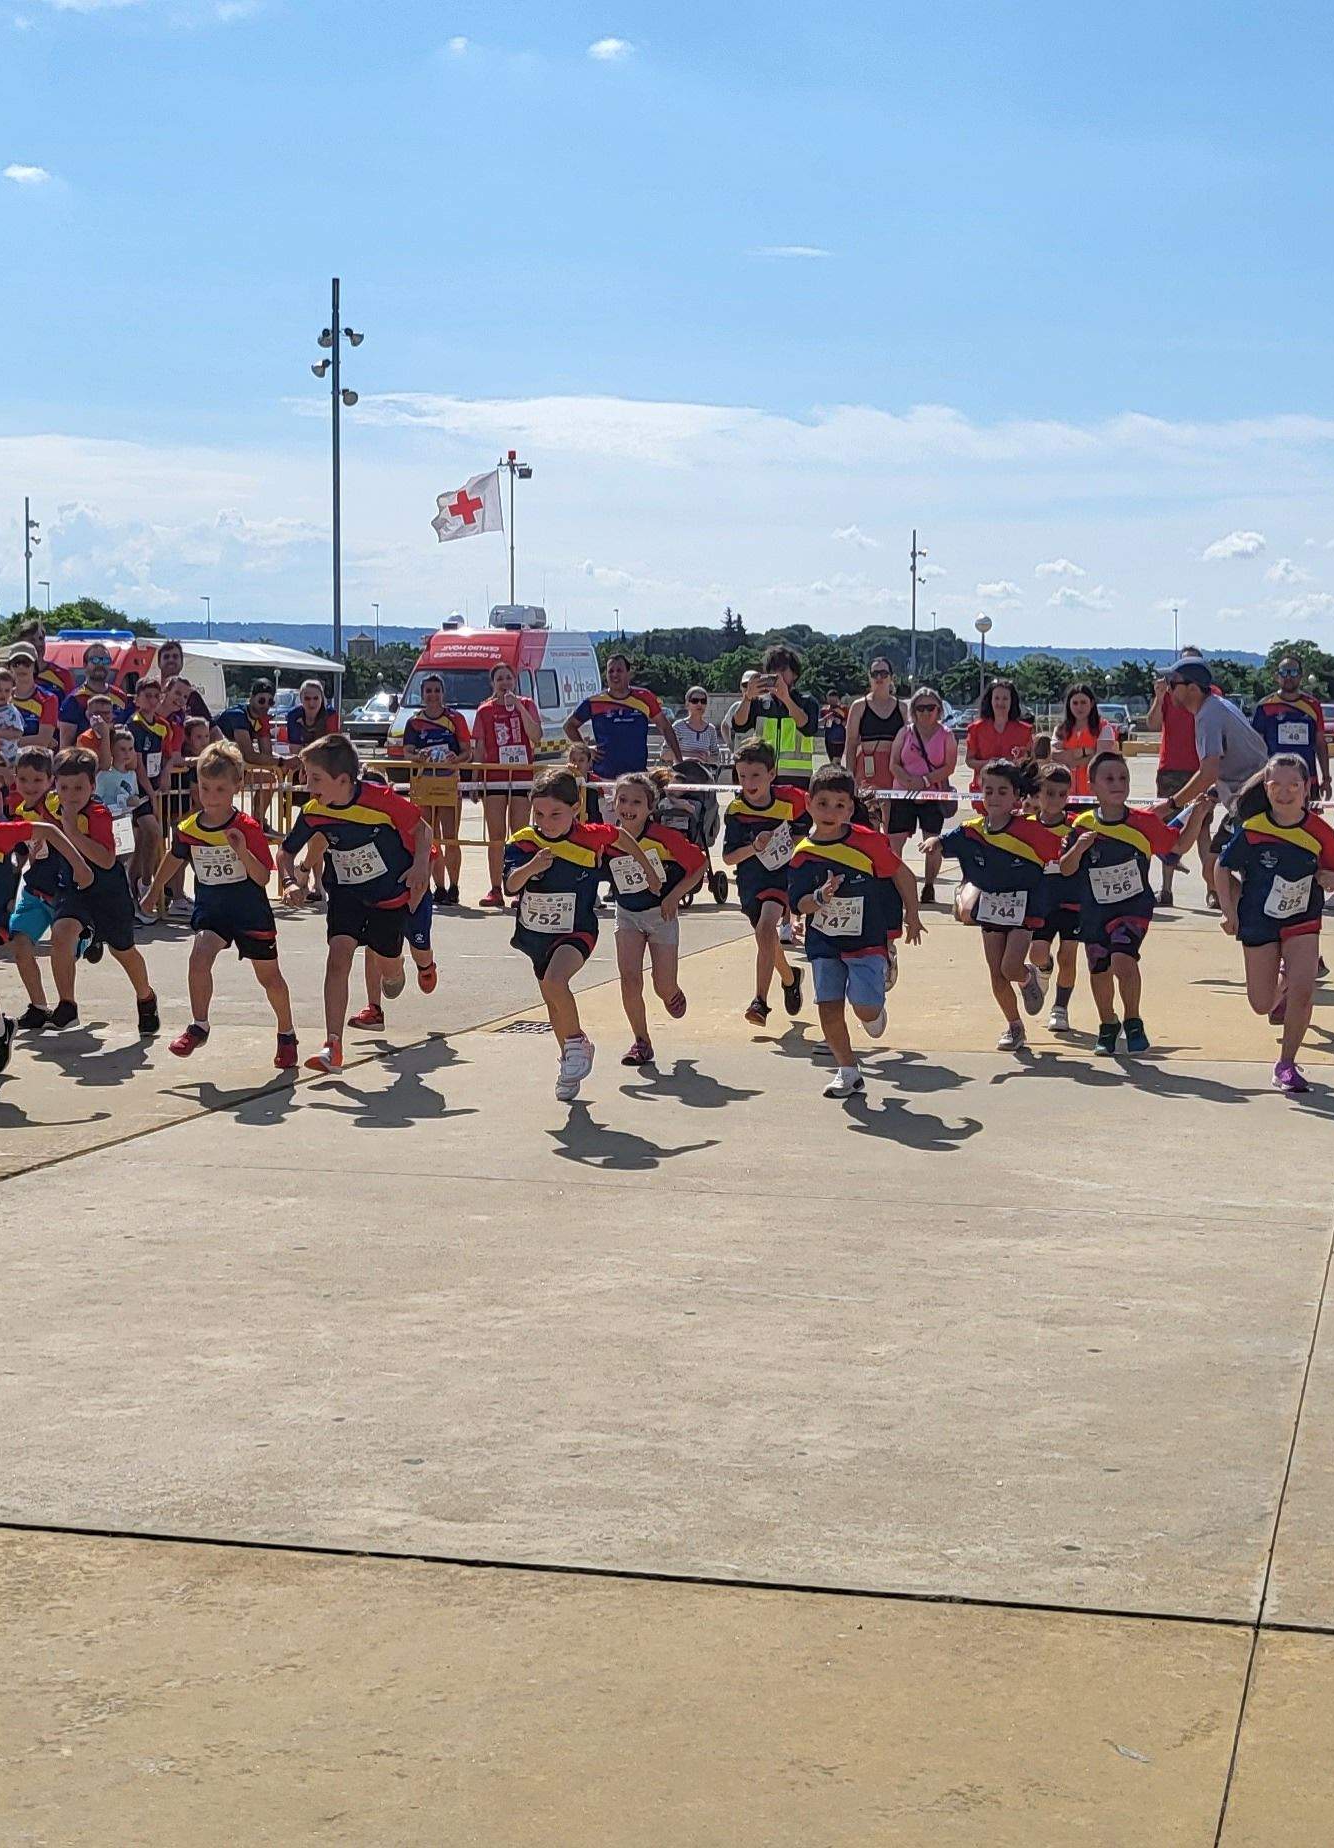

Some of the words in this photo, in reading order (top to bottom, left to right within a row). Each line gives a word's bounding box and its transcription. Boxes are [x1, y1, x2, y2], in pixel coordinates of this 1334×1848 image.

[769, 839, 793, 861] 799
[202, 863, 234, 878] 736
[343, 862, 374, 878] 703
[624, 872, 644, 886] 83
[1102, 879, 1132, 896] 756
[527, 910, 562, 926] 752
[990, 903, 1016, 919] 744
[820, 911, 851, 929] 747
